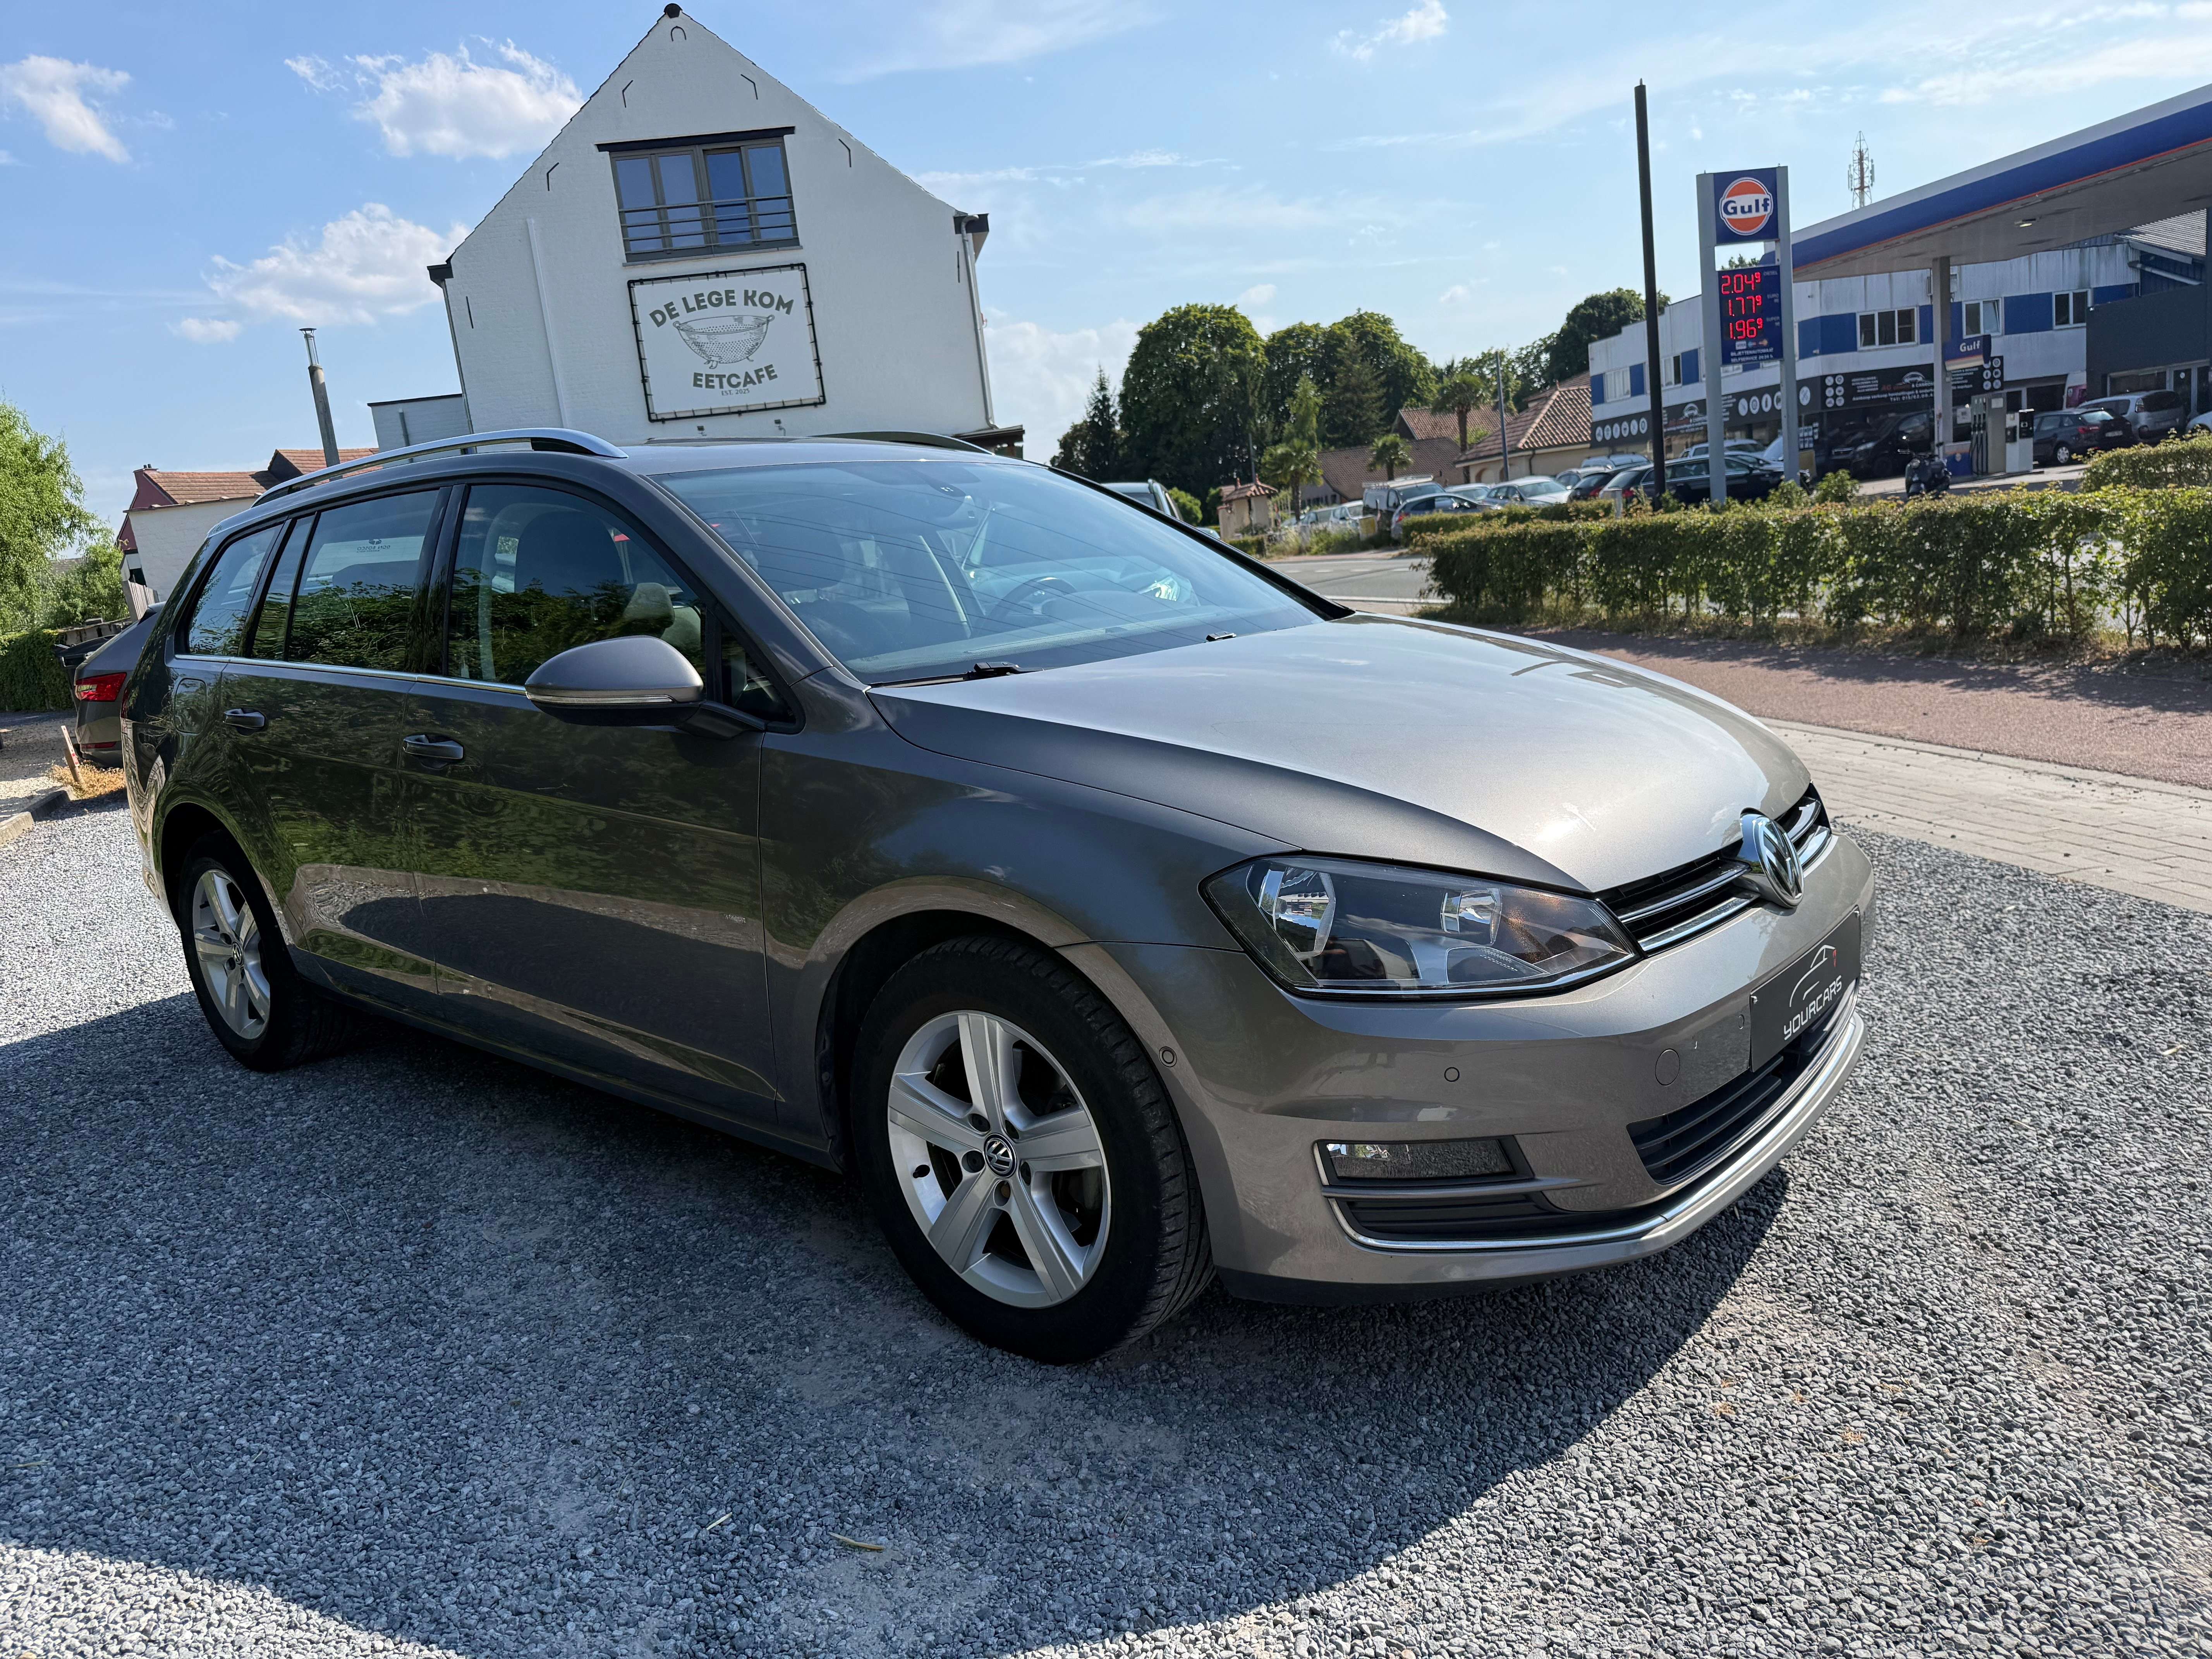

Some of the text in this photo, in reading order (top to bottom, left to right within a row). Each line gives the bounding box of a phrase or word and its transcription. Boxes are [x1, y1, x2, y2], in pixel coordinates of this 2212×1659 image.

[1723, 198, 1769, 215] Gulf
[1722, 272, 1761, 294] 2.049
[649, 290, 793, 327] DE LEGE KOM
[1729, 295, 1762, 316] 1.779
[1729, 318, 1763, 339] 1.969
[1960, 341, 1980, 352] Gulf
[693, 364, 778, 389] EETCAFE
[1784, 975, 1841, 1041] YOURCARS
